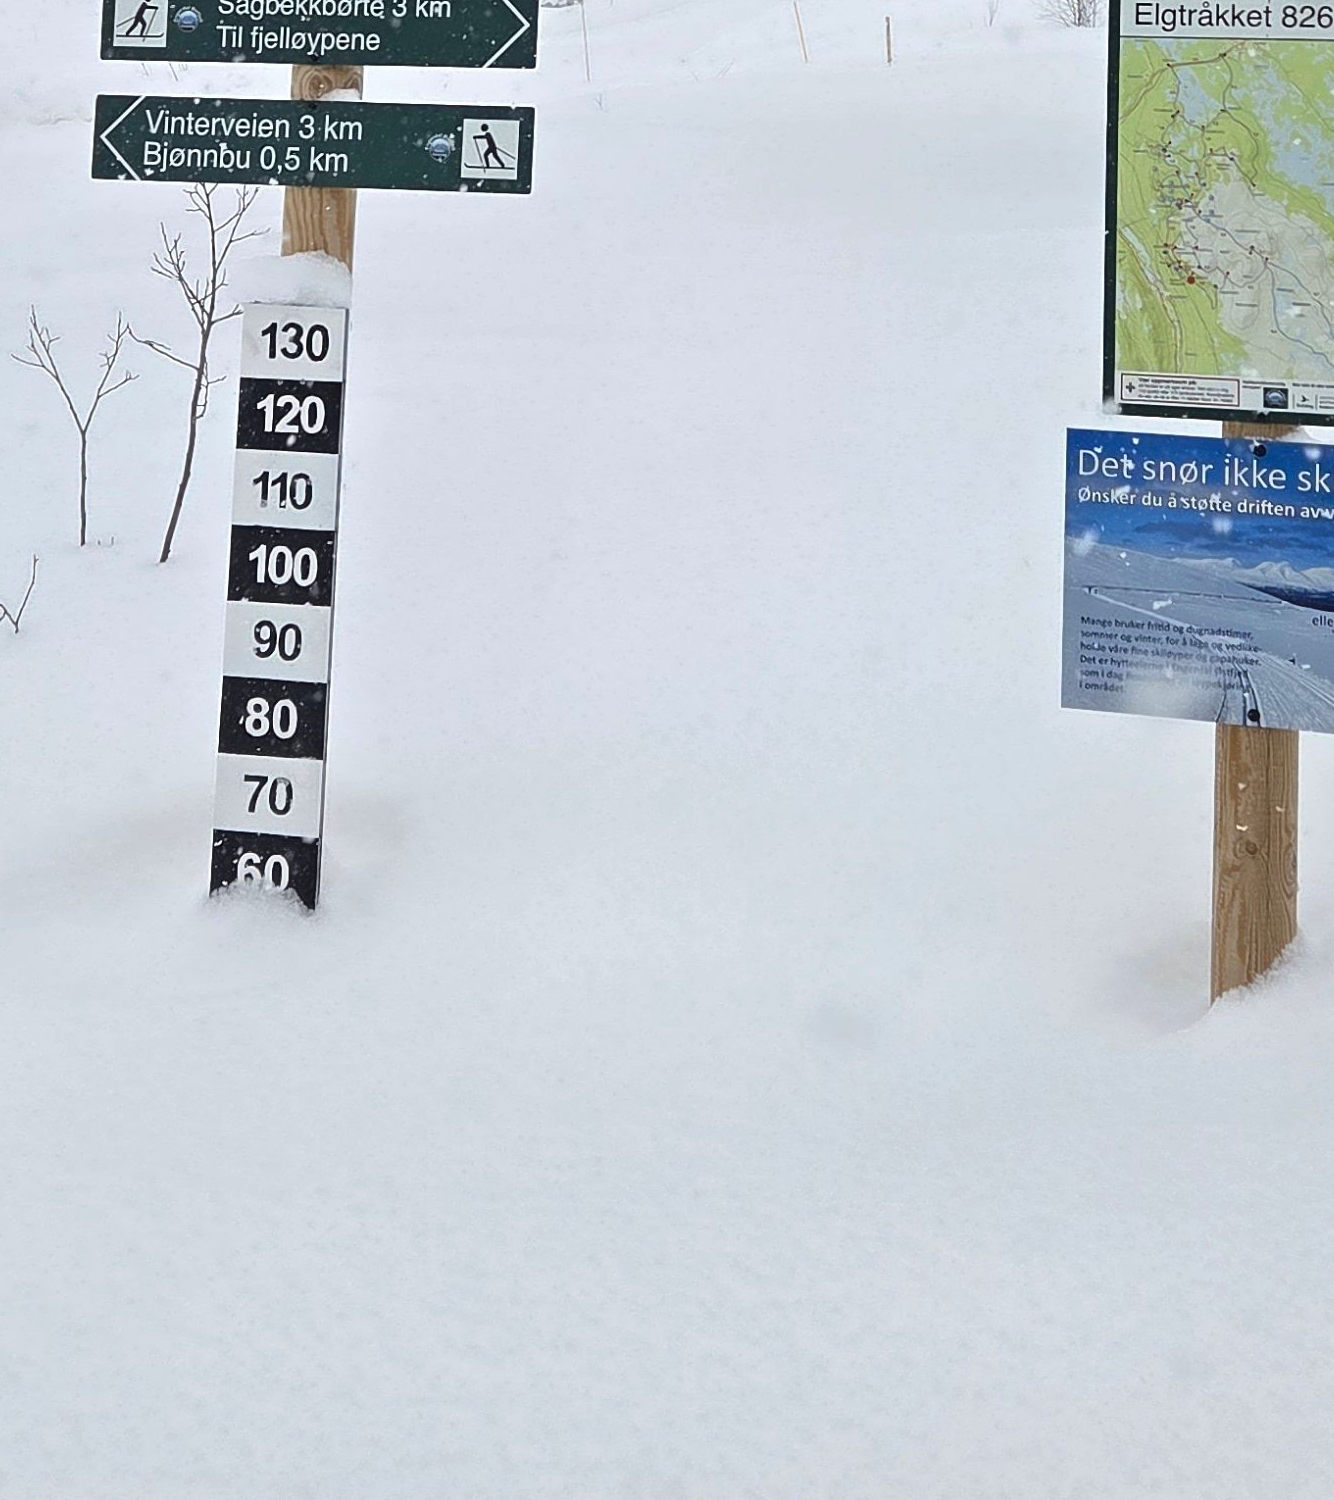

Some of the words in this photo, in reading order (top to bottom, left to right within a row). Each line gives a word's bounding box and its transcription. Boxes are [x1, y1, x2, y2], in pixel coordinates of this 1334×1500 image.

[1135, 1, 1272, 32] Elgtråkket
[1281, 5, 1334, 28] 826
[216, 25, 243, 48] Til
[250, 26, 380, 56] fjelløypene
[145, 109, 290, 138] Vinterveien
[298, 114, 315, 138] 3
[324, 114, 363, 140] km
[143, 141, 251, 172] Bjønnbu
[260, 145, 300, 174] 0,5
[309, 146, 348, 172] km
[261, 322, 329, 362] 130
[256, 394, 325, 435] 120
[1079, 449, 1133, 478] Det
[1143, 459, 1213, 486] snør
[1224, 457, 1287, 490] ikke
[252, 471, 312, 510] 110
[1078, 485, 1136, 505] Ønsker
[1142, 491, 1162, 507] du
[1168, 493, 1177, 508] å
[1237, 500, 1295, 518] driften
[248, 545, 318, 586] 100
[253, 620, 302, 661] 90
[1080, 615, 1113, 628] Mange
[1116, 618, 1145, 630] bruker
[1172, 624, 1184, 634] og
[1120, 633, 1132, 644] og
[1080, 654, 1096, 665] Det
[1098, 657, 1109, 666] er
[244, 698, 298, 739] 80
[244, 774, 293, 815] 70
